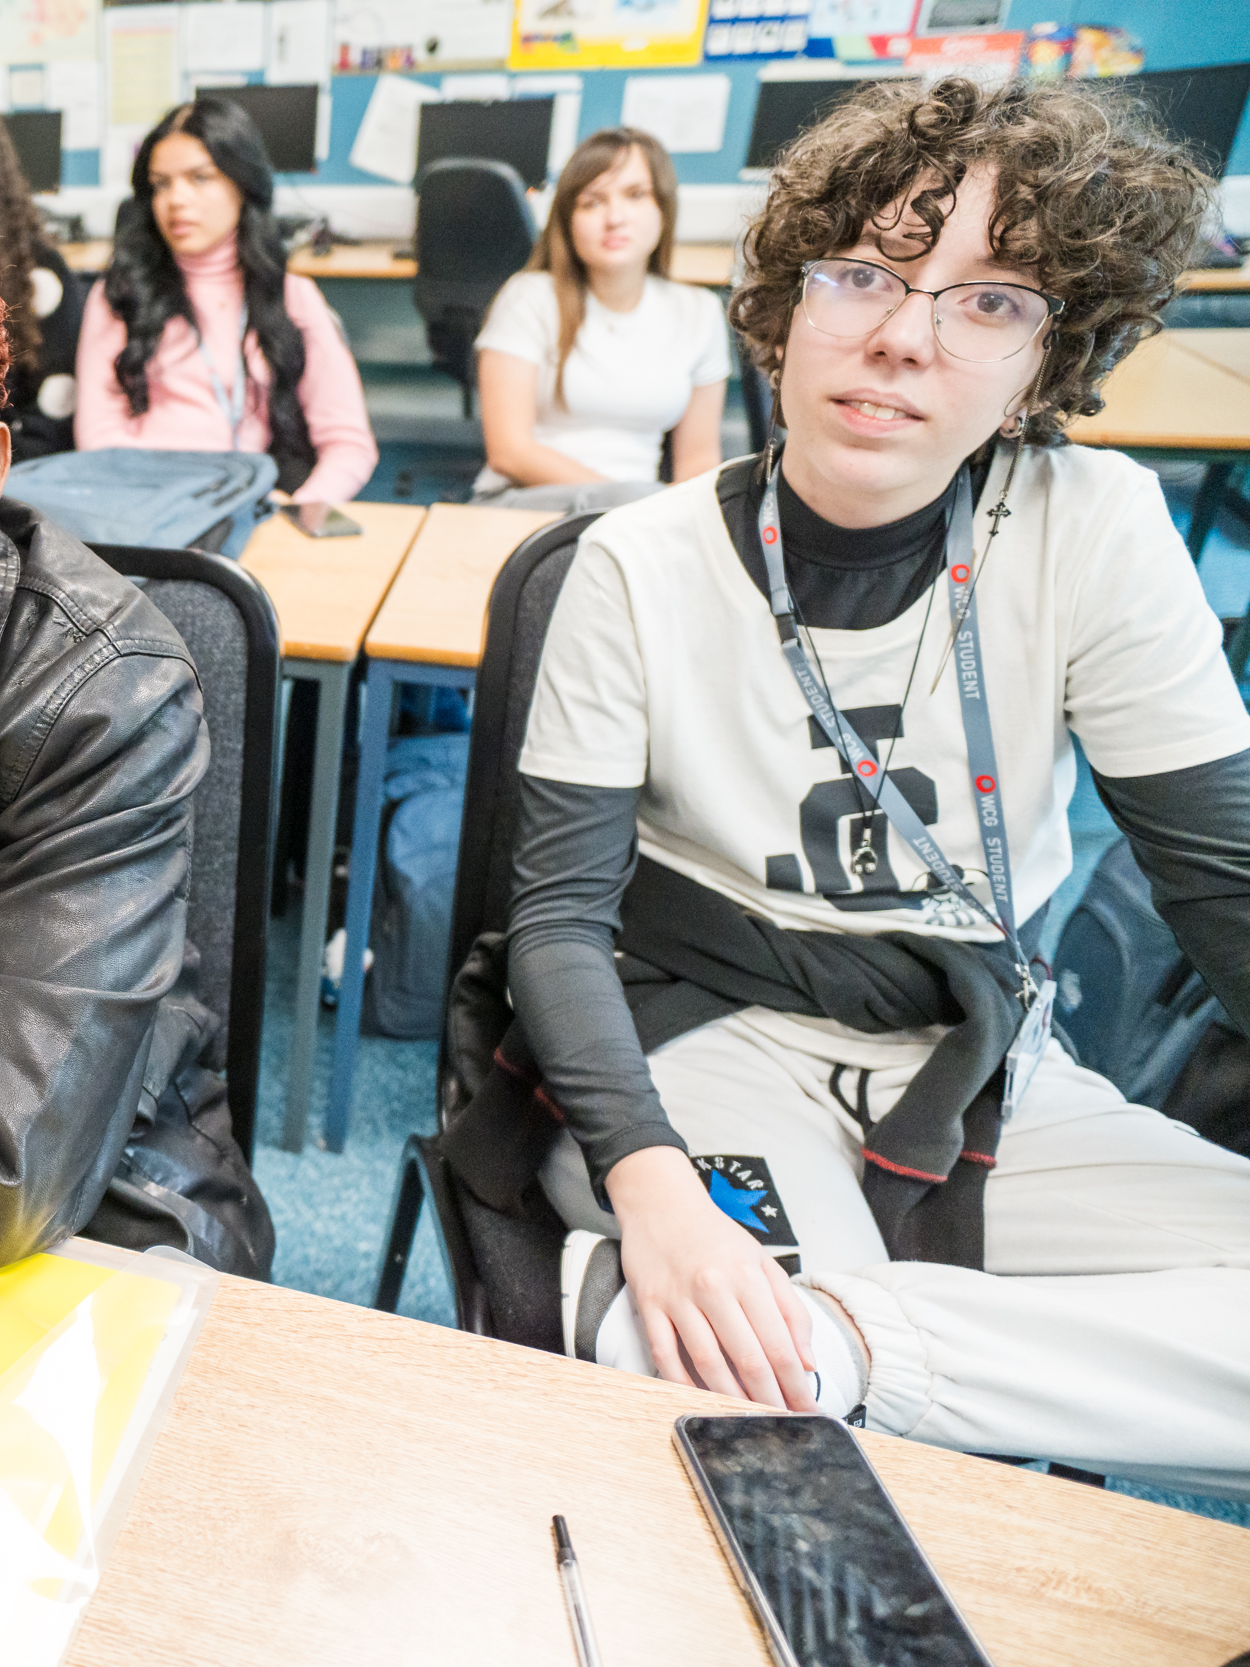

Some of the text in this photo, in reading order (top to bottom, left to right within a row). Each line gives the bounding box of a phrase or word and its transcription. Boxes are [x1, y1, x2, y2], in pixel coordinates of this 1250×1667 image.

[958, 631, 981, 699] STUDENT
[797, 669, 836, 728] STUDENT
[913, 835, 963, 894] STUDENT
[980, 794, 1009, 904] WCG STUDENT
